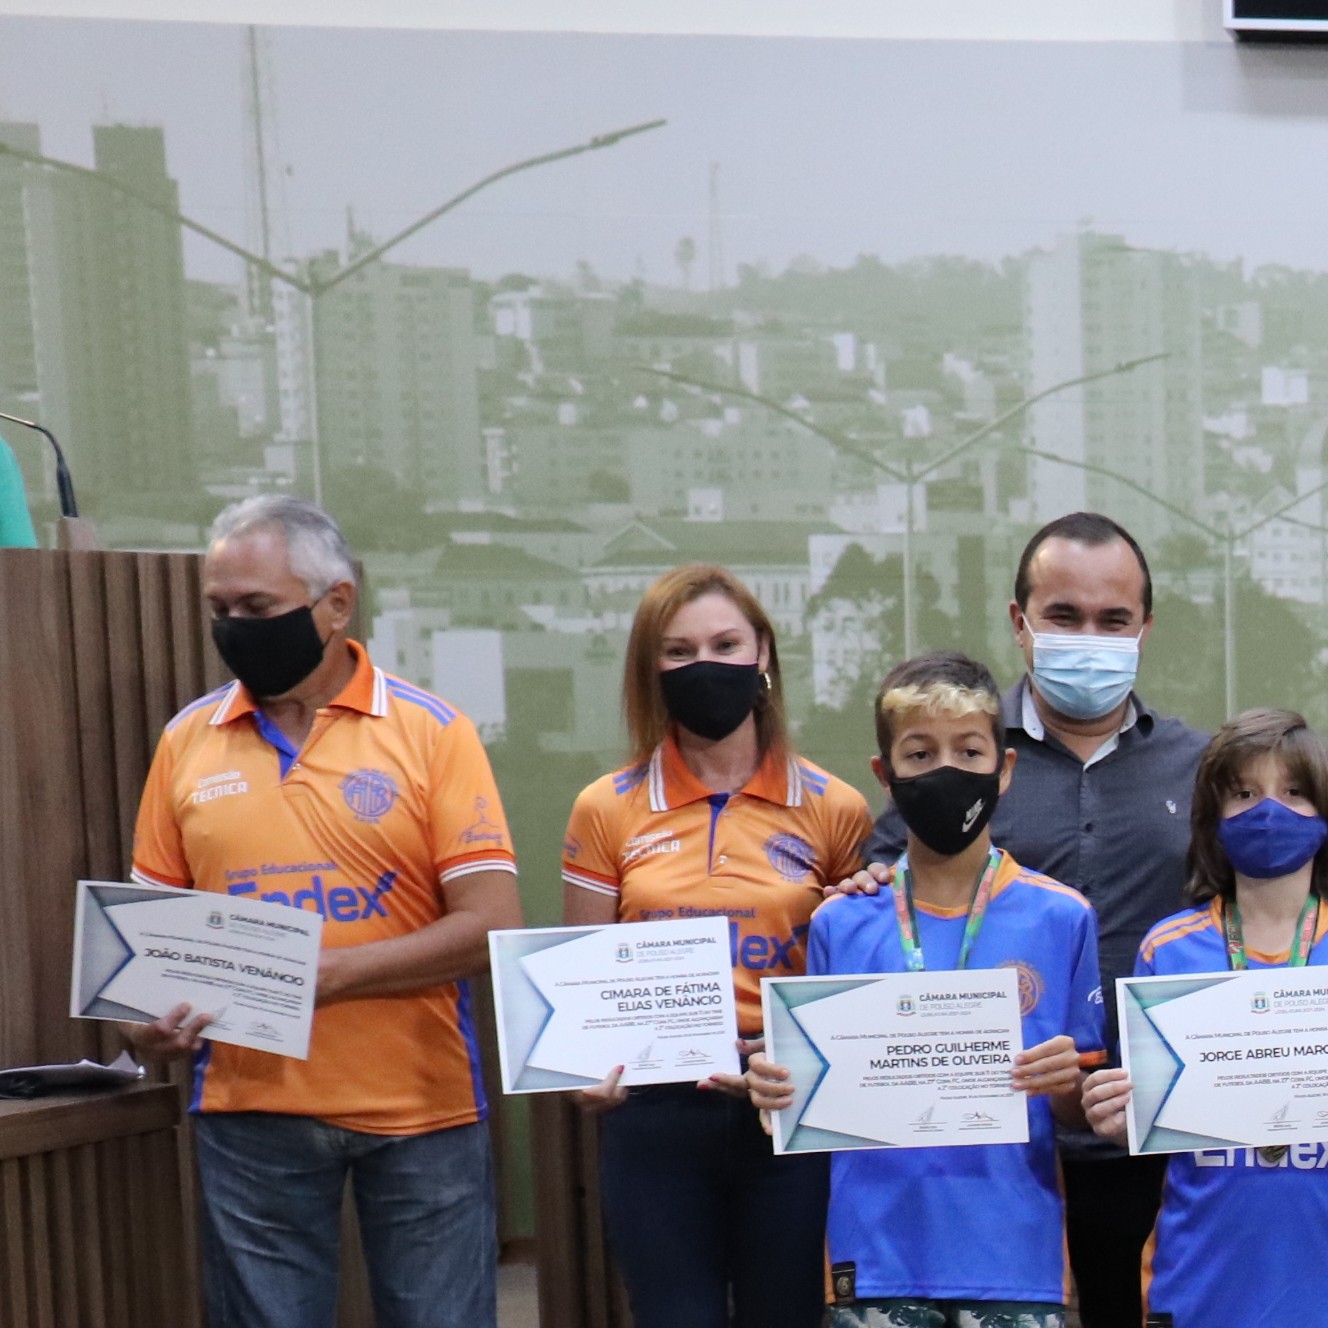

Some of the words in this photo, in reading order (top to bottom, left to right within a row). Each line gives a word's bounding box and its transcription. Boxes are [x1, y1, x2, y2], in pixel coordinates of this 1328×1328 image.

[261, 862, 338, 874] Educacional
[678, 906, 756, 918] Educacional
[636, 939, 671, 949] CÂMARA
[673, 937, 716, 945] MUNICIPAL
[145, 948, 181, 960] JOÃO
[184, 954, 235, 970] BATISTA
[239, 964, 304, 986] VENÂNCIO
[601, 987, 650, 1000] CIMARA
[655, 986, 672, 996] DE
[675, 982, 720, 994] FÁTIMA
[919, 992, 956, 1002] CÂMARA
[959, 991, 1007, 999] MUNICIPAL
[1273, 988, 1310, 999] CÂMARA
[618, 999, 652, 1012] ELIAS
[655, 994, 722, 1009] VENÂNCIO
[887, 1044, 931, 1055] PEDRO
[935, 1040, 1010, 1053] GUILHERME
[1200, 1051, 1242, 1063] JORGE
[1246, 1047, 1290, 1059] ABREU
[870, 1057, 928, 1070] MARTINS
[932, 1056, 950, 1066] DE
[953, 1053, 1011, 1065] OLIVEIRA
